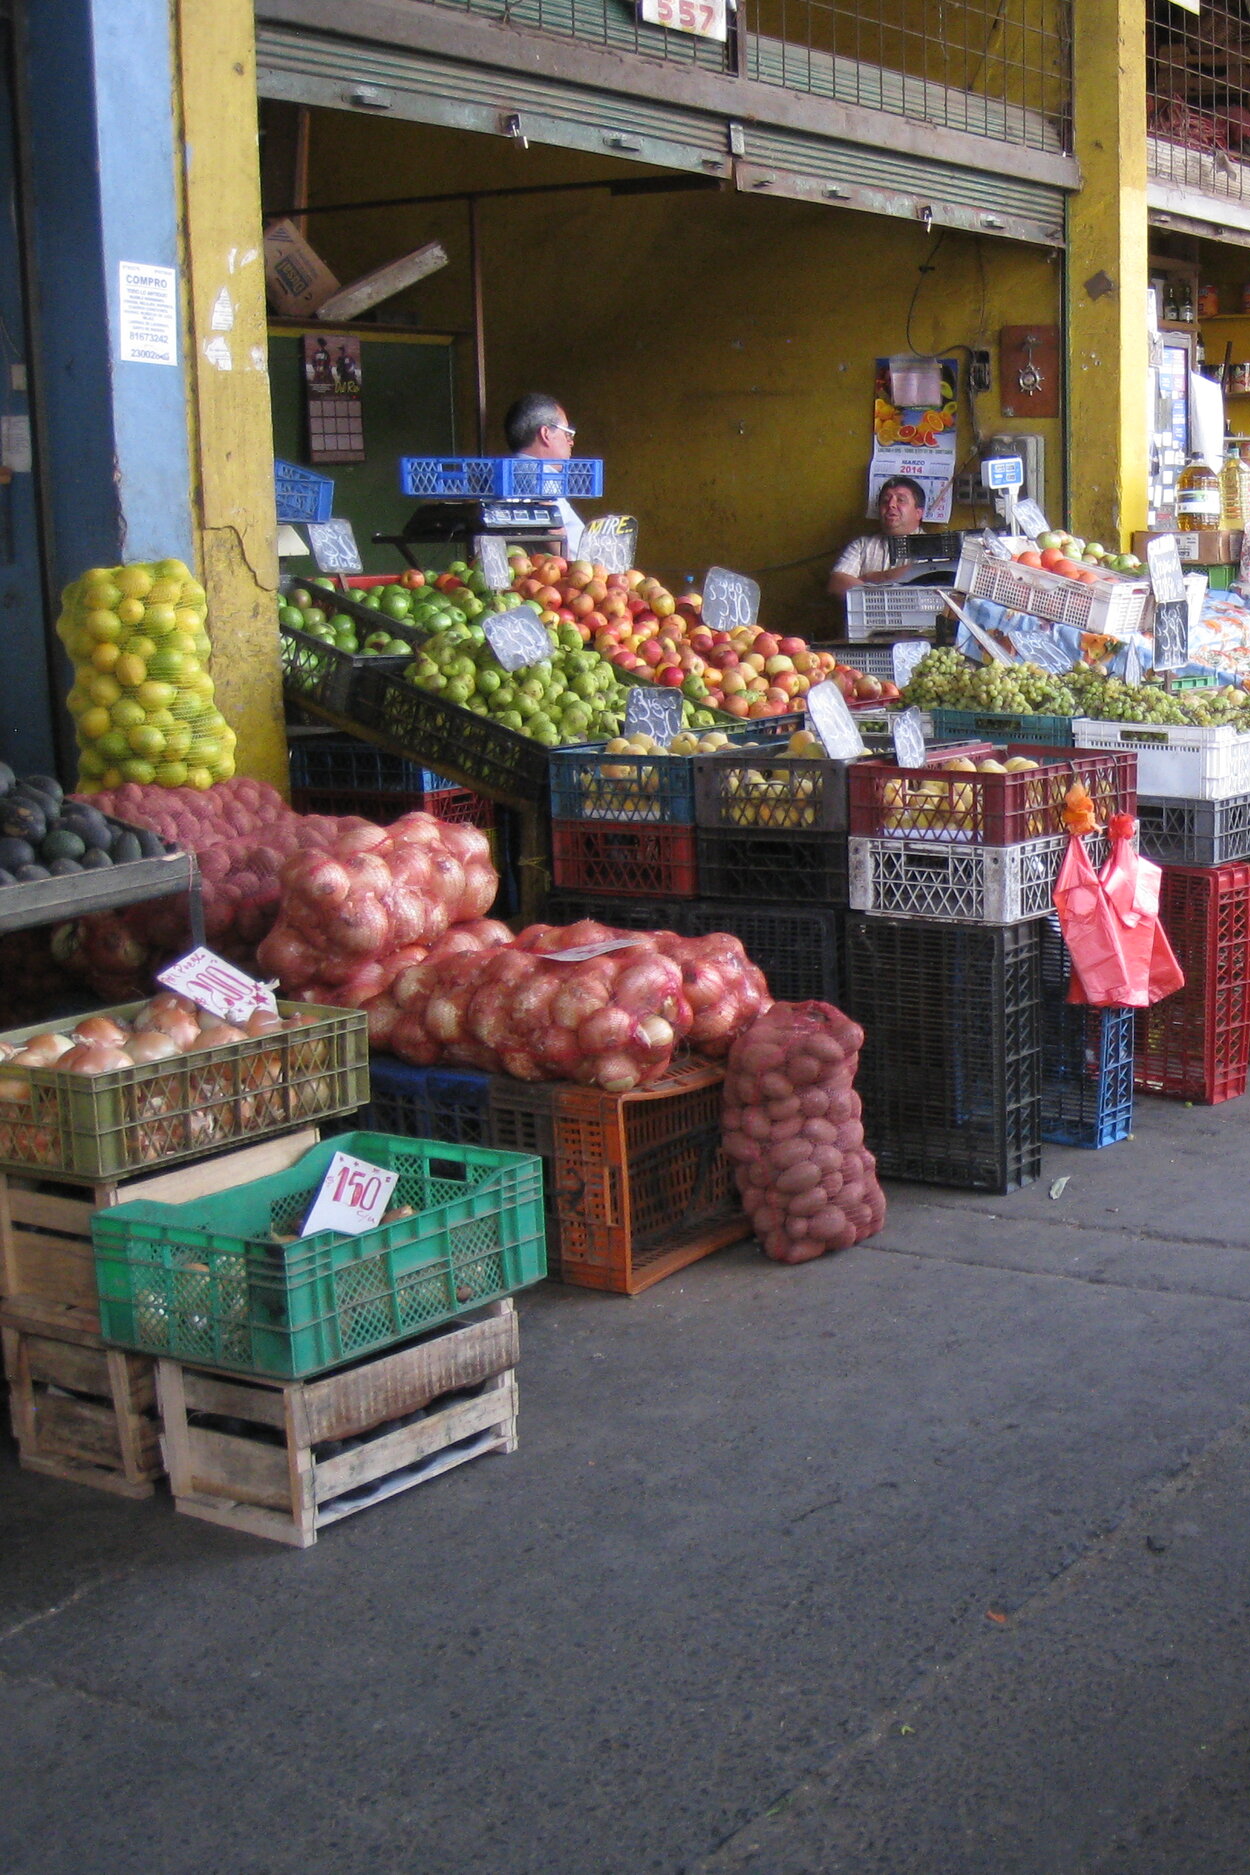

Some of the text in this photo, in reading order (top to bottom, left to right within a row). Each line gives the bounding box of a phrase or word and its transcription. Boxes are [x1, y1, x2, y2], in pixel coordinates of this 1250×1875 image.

[126, 274, 168, 289] COMPRO
[900, 466, 923, 474] 2014
[331, 1166, 382, 1211] 150
